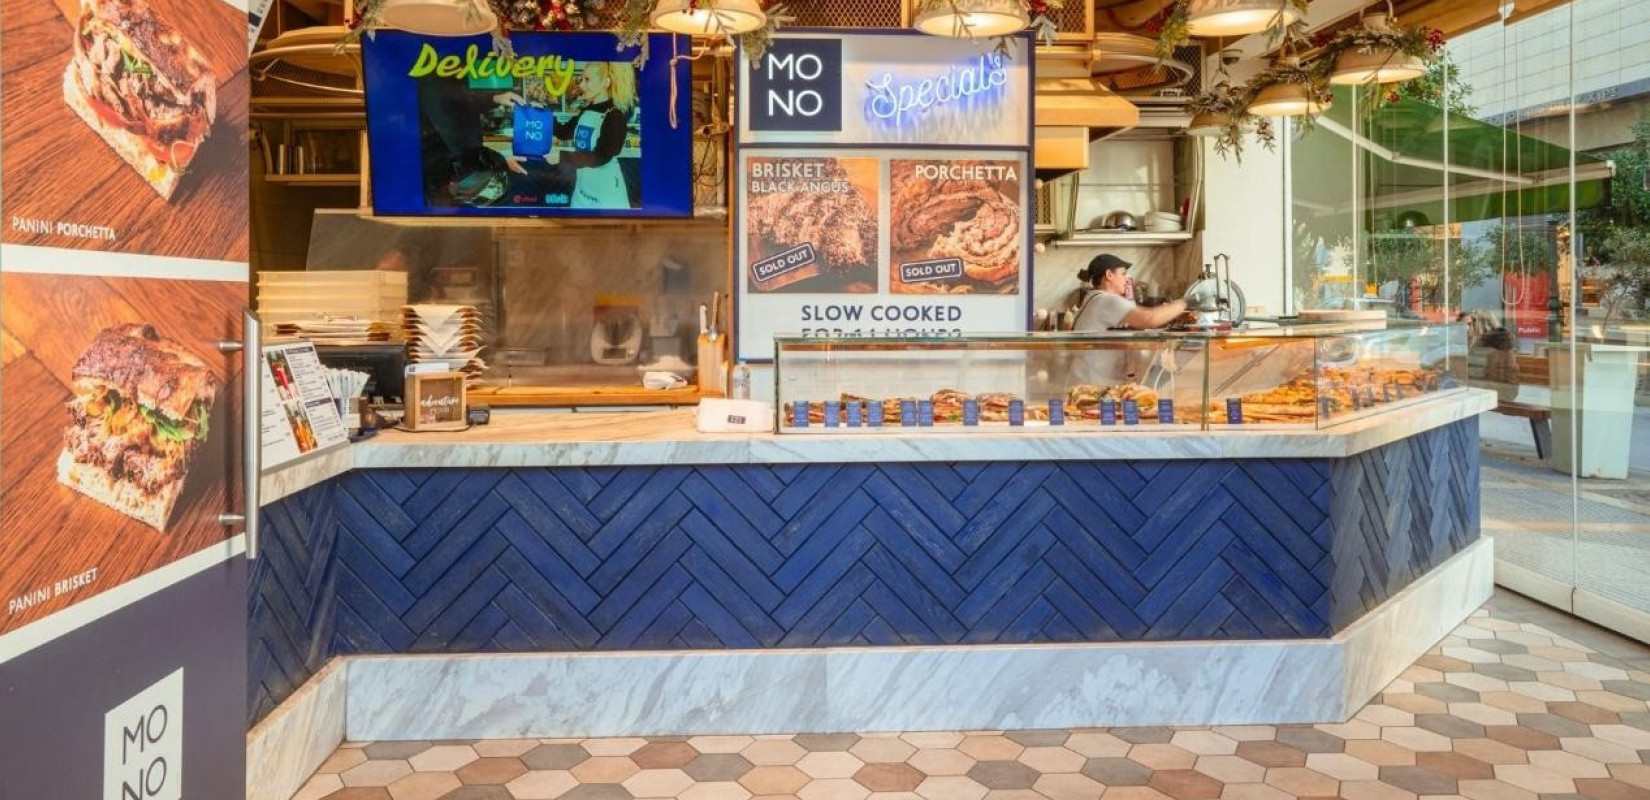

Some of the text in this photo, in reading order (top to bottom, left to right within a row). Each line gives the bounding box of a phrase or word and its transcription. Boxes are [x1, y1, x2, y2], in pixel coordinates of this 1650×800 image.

[408, 43, 575, 96] Delivery
[768, 53, 823, 80] MO
[768, 89, 823, 117] NO
[525, 120, 543, 130] MO
[525, 131, 543, 141] NO
[752, 163, 824, 178] BRISKET
[915, 165, 1017, 180] PORCHETTA
[751, 181, 849, 193] BLACK ANGUS
[12, 216, 116, 240] PANINI PORCHETTA
[759, 249, 808, 275] SOLD OUT
[905, 263, 957, 277] SOLD OUT
[801, 305, 962, 321] SLOW COOKED
[9, 567, 98, 614] PANINI BRISKET
[123, 704, 168, 766] MO
[122, 756, 167, 800] NO
